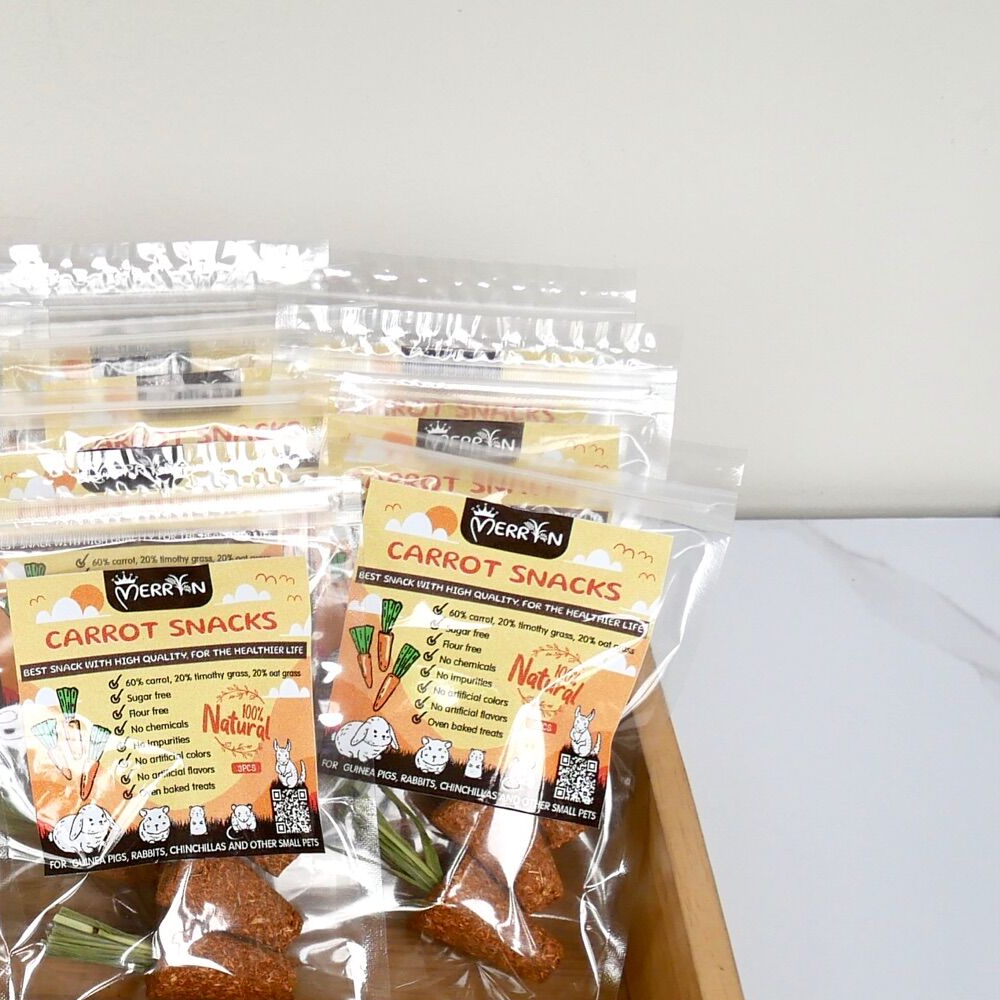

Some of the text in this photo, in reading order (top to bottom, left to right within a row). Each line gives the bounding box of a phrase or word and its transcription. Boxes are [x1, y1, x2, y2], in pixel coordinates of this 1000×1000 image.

[92, 558, 110, 566] 60%
[112, 556, 138, 566] carrot,
[140, 555, 158, 564] 20%
[160, 554, 189, 565] timothy
[191, 555, 215, 565] grass,
[387, 541, 622, 601] CARROT SNACKS
[358, 571, 382, 582] BEST
[383, 574, 415, 588] SNACK
[416, 580, 444, 592] WITH
[446, 584, 472, 597] HIGH
[522, 600, 542, 611] FOR
[544, 604, 564, 615] THE
[622, 621, 645, 634] LIFE
[45, 611, 278, 649] CARROT SNACKS
[449, 609, 467, 620] 60%
[469, 612, 495, 626] carrot,
[498, 617, 516, 628] 20%
[518, 620, 549, 635] timothy
[550, 628, 576, 642] grass,
[577, 634, 597, 646] 20%
[598, 639, 612, 649] oat
[473, 630, 490, 640] free
[442, 639, 482, 654] Flour free
[23, 666, 47, 677] BEST
[50, 662, 83, 674] SNACK
[84, 658, 113, 669] WITH
[115, 655, 141, 667] HIGH
[191, 649, 210, 659] FOR
[213, 647, 232, 656] THE
[234, 645, 284, 656] HEALTHIER
[285, 645, 304, 655] LIFE
[439, 655, 496, 673] No chemicals
[125, 668, 301, 687] 60% carrot, 20% timothy grass, 20% oat grass
[436, 670, 493, 688] No impurities
[508, 654, 584, 705] Natural
[127, 690, 172, 704] Sugar free
[433, 686, 509, 707] No artificial colors
[129, 706, 169, 718] Flour free
[242, 703, 264, 721] 100%
[430, 702, 508, 723] No artificial flavors
[131, 720, 189, 734] No chemicals
[202, 703, 271, 741] Natural
[428, 717, 504, 738] Oven baked treats
[135, 756, 148, 765] No
[186, 750, 211, 760] colors
[137, 765, 216, 781] No aricial flavors
[163, 783, 190, 795] baked
[192, 781, 216, 791] treats
[321, 758, 339, 769] FOR
[343, 764, 375, 777] GUINEA
[377, 769, 398, 782] PIGS,
[400, 774, 437, 790] RABBITS,
[440, 781, 497, 800] CHINCHILLAS
[523, 797, 550, 811] OHER
[552, 802, 577, 816] SMALL
[578, 808, 597, 820] PETS
[50, 860, 67, 870] FOR
[107, 852, 130, 864] PIGS,
[131, 849, 168, 861] RABBITS,
[169, 842, 227, 855] CHINCHILLAS
[228, 840, 249, 851] AND
[250, 839, 277, 849] OTHER
[278, 838, 301, 849] SMALL
[302, 837, 320, 847] PETS
